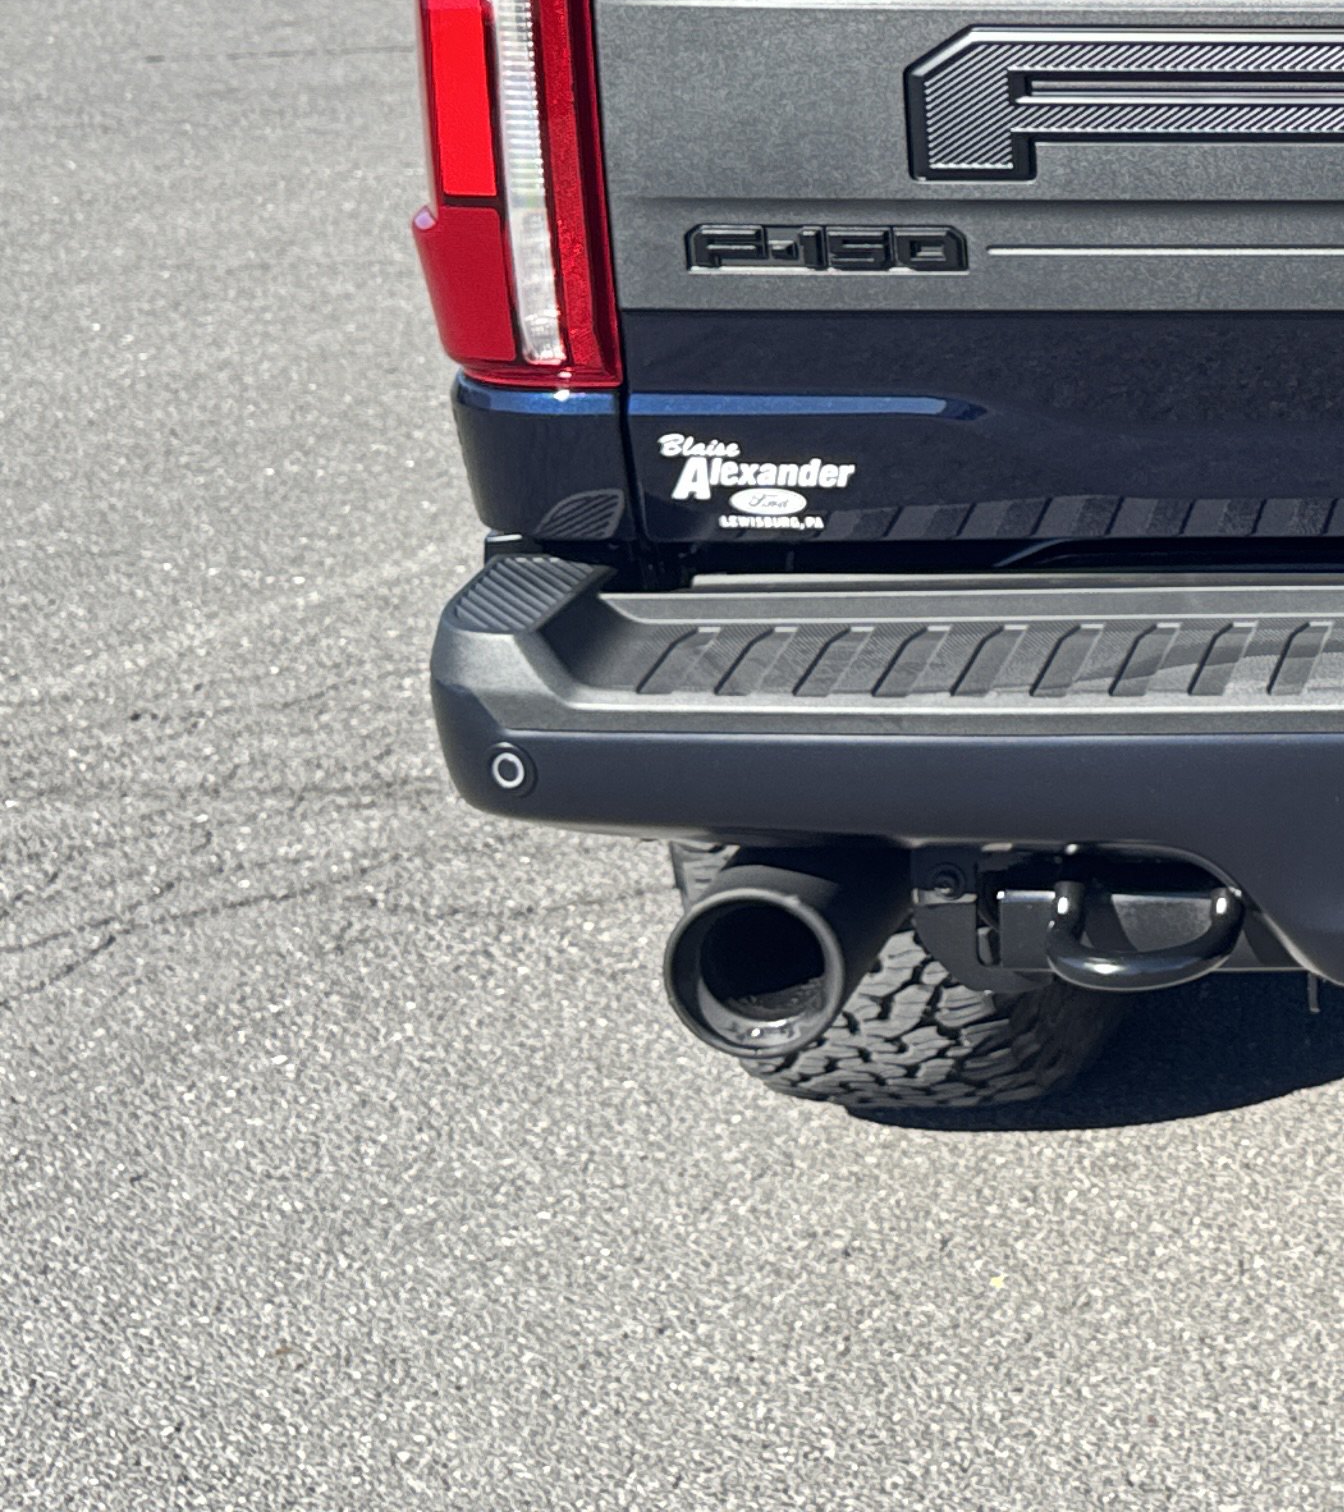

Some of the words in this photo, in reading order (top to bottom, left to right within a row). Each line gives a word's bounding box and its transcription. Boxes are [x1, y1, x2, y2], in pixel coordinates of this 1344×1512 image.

[685, 224, 969, 273] F-150
[657, 433, 741, 457] Blaise
[671, 456, 856, 500] Alexander
